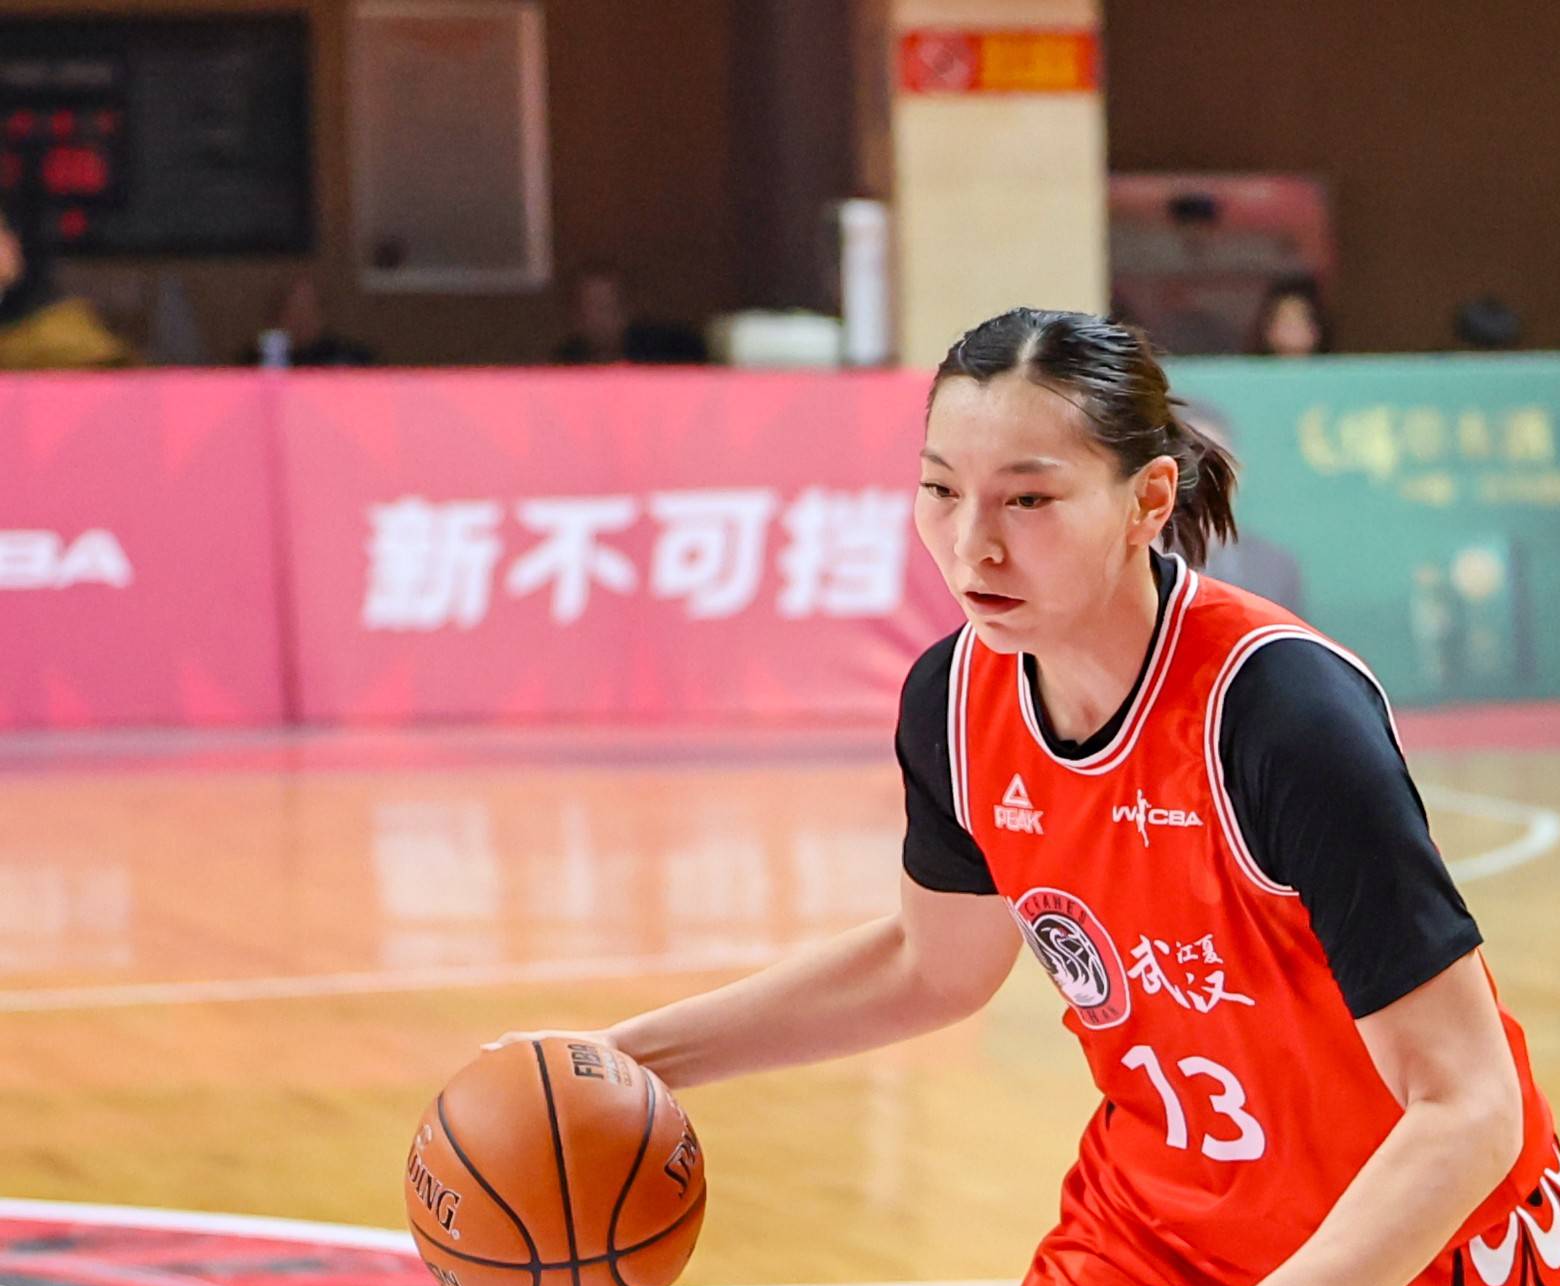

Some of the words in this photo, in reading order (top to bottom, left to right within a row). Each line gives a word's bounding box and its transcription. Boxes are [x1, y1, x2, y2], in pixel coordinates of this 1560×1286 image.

[993, 804, 1044, 835] PEAK
[1112, 803, 1203, 828] WCBA
[1126, 934, 1256, 1014] 武汉
[1120, 1044, 1266, 1162] 13
